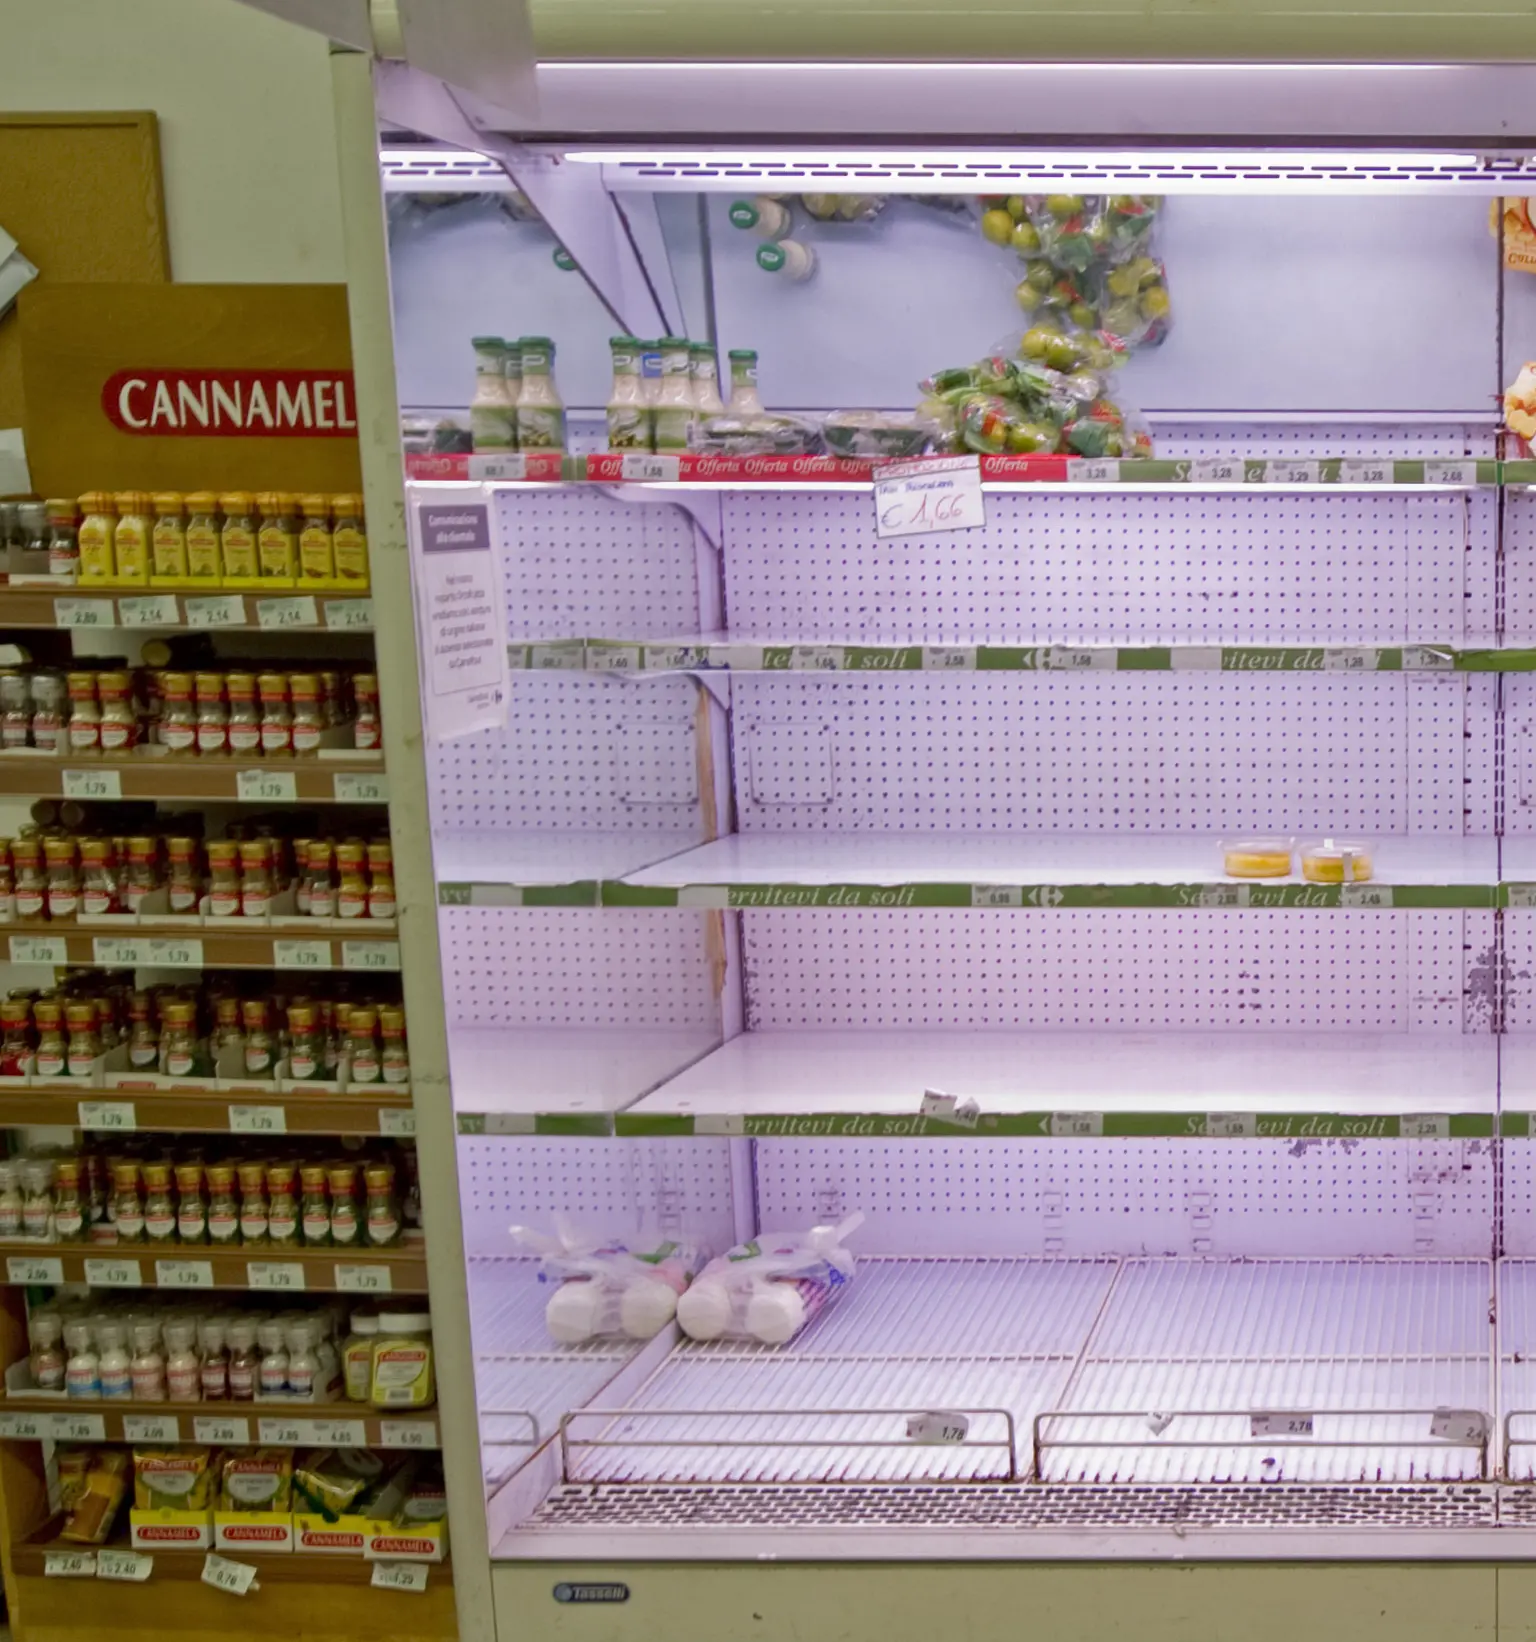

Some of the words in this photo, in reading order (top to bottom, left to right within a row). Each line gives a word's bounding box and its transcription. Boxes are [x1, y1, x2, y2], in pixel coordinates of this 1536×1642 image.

[119, 379, 357, 428] CANNAMEL
[697, 458, 739, 475] Offerta
[745, 458, 787, 475] Offerta
[793, 458, 835, 475] Offerta
[984, 456, 1029, 474] Offerta
[910, 493, 965, 530] 1,66
[861, 648, 908, 669] soli
[728, 886, 820, 904] ervitevi
[827, 886, 861, 904] da
[869, 886, 915, 905] soli
[743, 1115, 836, 1134] ervitevi
[842, 1115, 876, 1134] da
[883, 1115, 928, 1134] soli
[1300, 1116, 1334, 1136] da
[1341, 1116, 1387, 1136] soli
